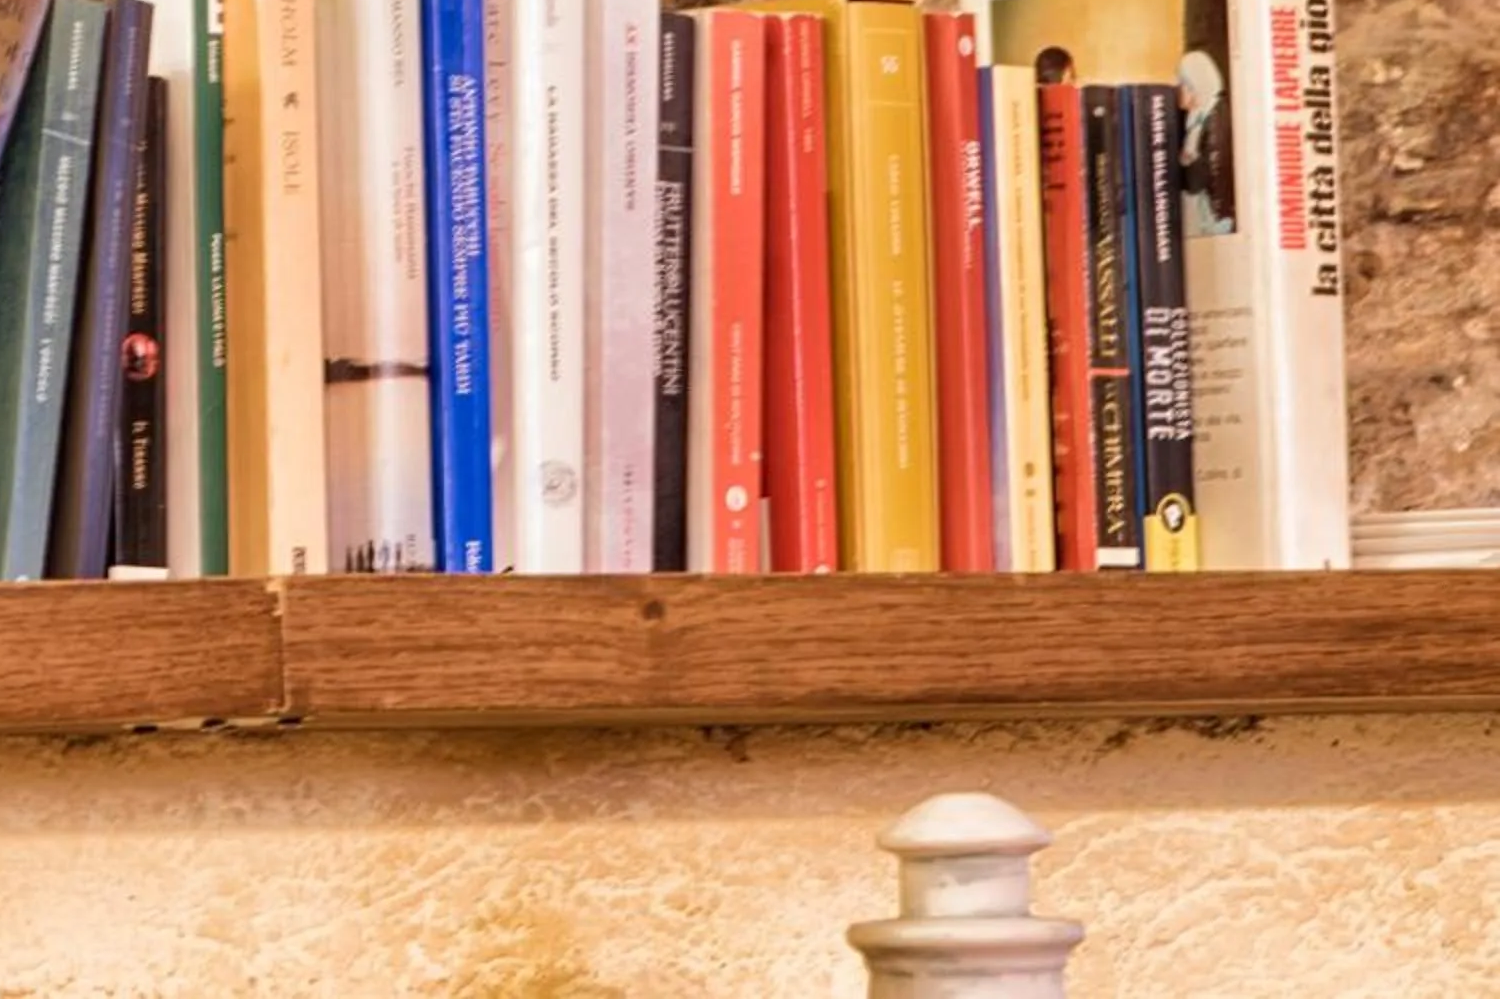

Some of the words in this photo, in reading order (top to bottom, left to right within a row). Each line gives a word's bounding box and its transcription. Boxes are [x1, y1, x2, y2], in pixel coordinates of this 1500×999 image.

[484, 61, 506, 123] Levy
[1270, 6, 1301, 113] LAPIERRE
[462, 75, 478, 160] ANTONIO
[1151, 94, 1166, 144] MARK
[1304, 64, 1335, 155] della
[280, 130, 302, 195] ISOLE
[964, 139, 983, 229] ORWELL
[1275, 121, 1306, 250] DOMINIQUE
[1153, 149, 1171, 262] BILLINGHAM
[451, 224, 467, 300] SEMPRE
[1311, 263, 1339, 297] la
[1144, 307, 1172, 335] DI
[454, 339, 471, 395] TARDI
[1145, 346, 1175, 440] MORTE
[1169, 307, 1191, 440] COLLEZIONISTA
